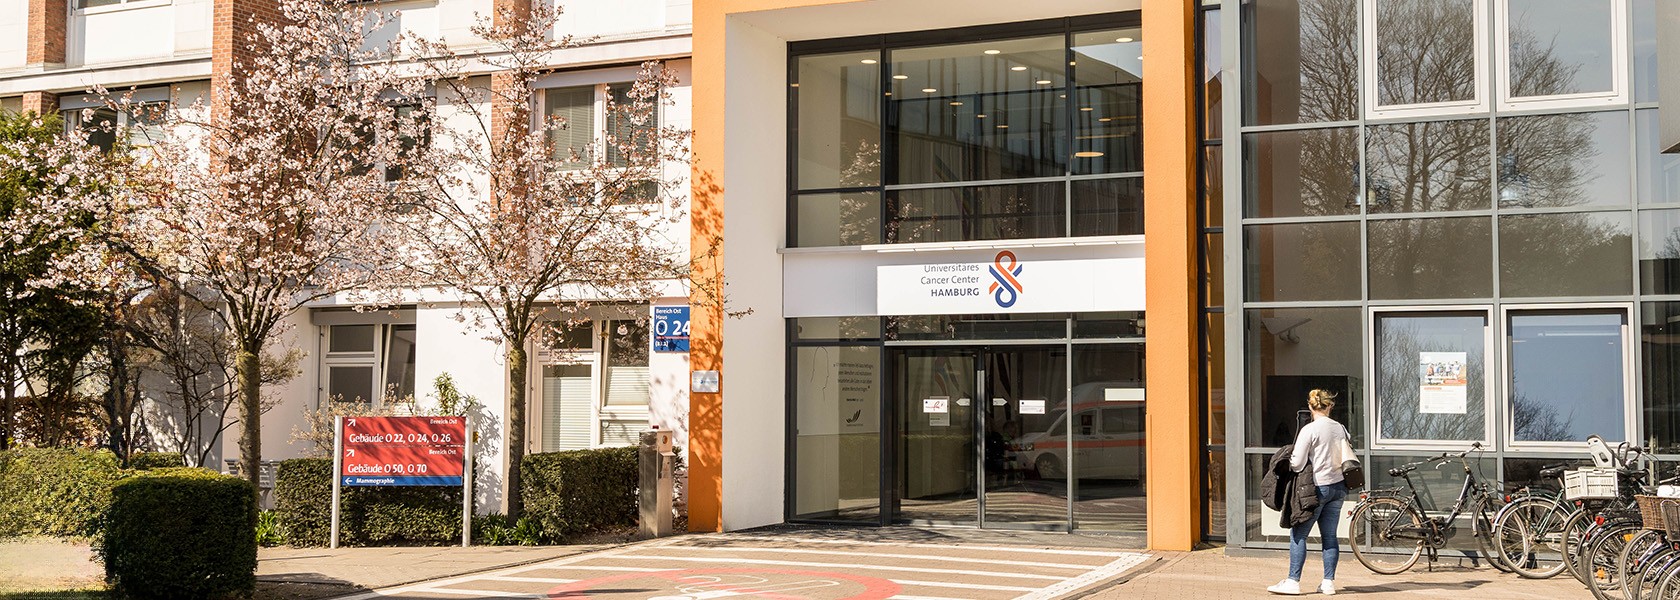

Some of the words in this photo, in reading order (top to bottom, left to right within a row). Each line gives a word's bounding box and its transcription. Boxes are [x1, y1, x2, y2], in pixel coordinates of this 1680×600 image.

[920, 276, 949, 285] Cancer
[951, 275, 980, 284] Center
[930, 288, 980, 297] HAMBURG
[655, 320, 668, 336] O
[672, 320, 690, 336] 24
[349, 433, 384, 443] Gebäude
[385, 434, 392, 443] O
[394, 434, 406, 444] 22,
[408, 434, 415, 443] O
[417, 434, 430, 444] 24,
[431, 434, 439, 443] O
[440, 434, 451, 443] 26
[347, 464, 383, 473] Gebäude
[384, 464, 391, 473] O
[393, 464, 405, 474] 50,
[407, 464, 414, 473] O
[417, 464, 427, 473] 70
[356, 477, 395, 485] Mammographie
